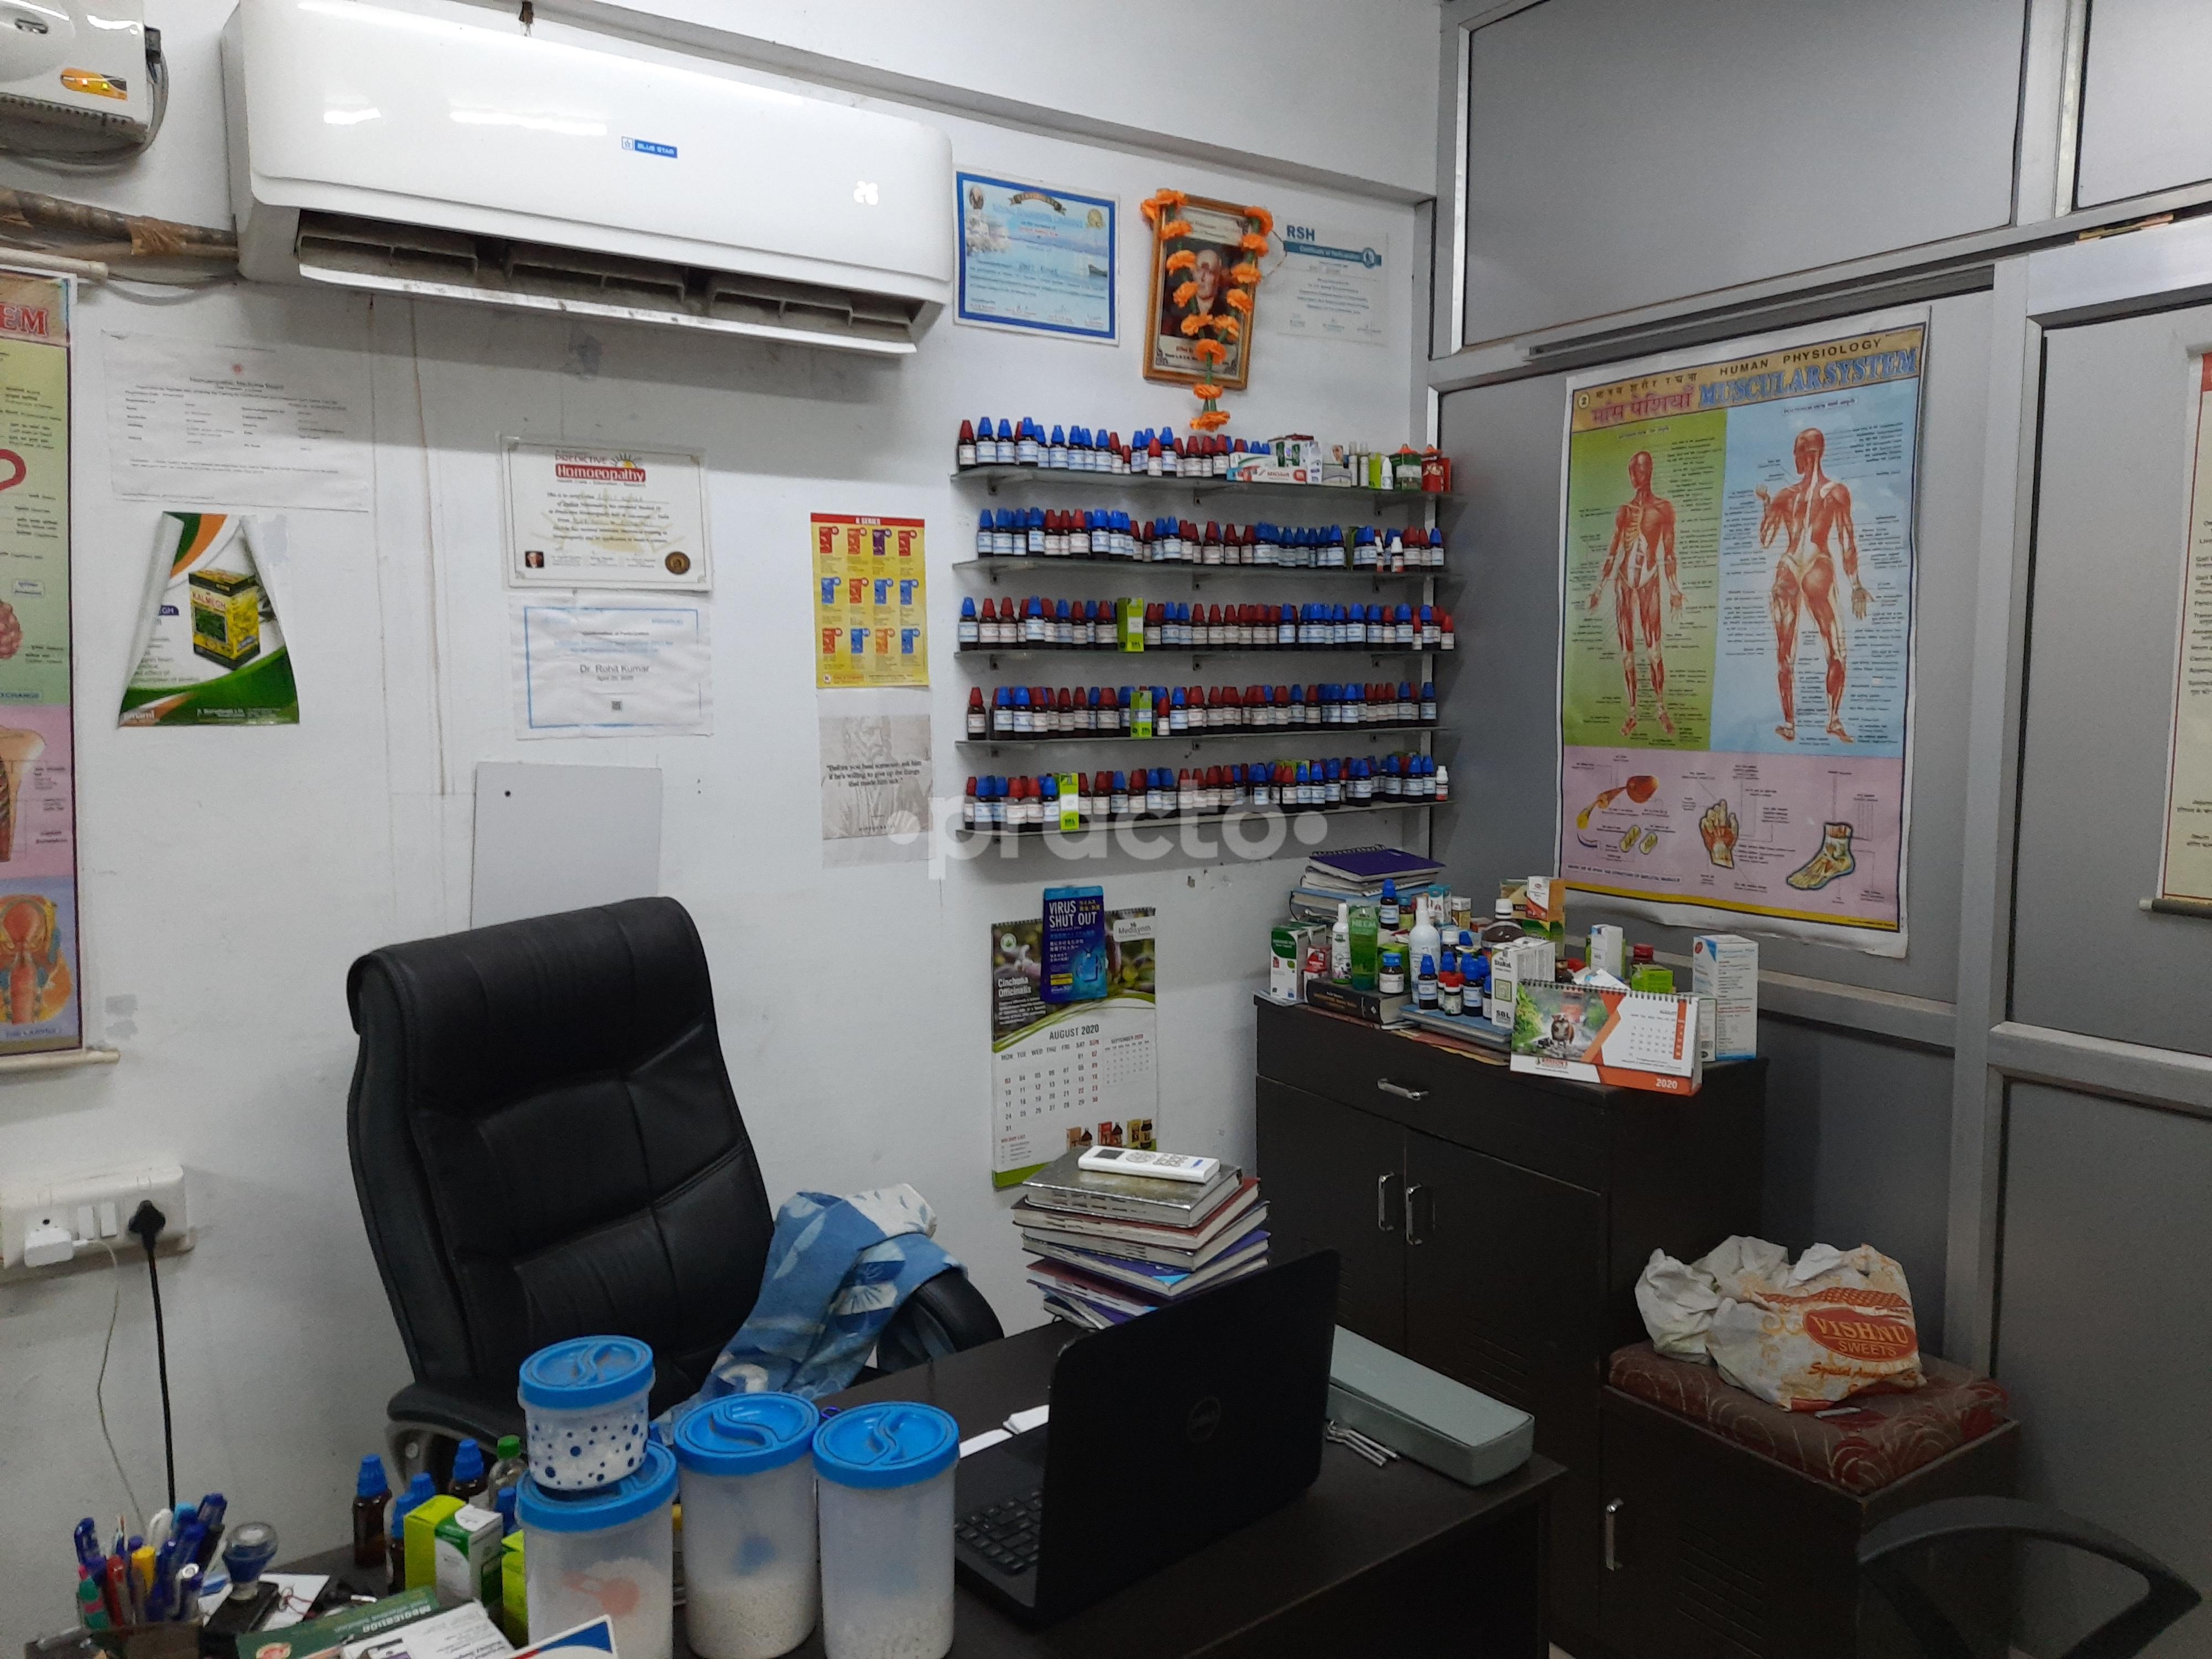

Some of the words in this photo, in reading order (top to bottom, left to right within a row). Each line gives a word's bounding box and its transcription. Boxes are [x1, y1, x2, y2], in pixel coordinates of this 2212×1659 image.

[637, 142, 655, 152] BLUE
[656, 145, 675, 155] STAR
[1286, 225, 1315, 241] RSH
[1719, 359, 1768, 376] HUMAN
[1782, 338, 1882, 364] PHYSIOLOGY
[557, 465, 644, 483] Homoeopathy
[1048, 900, 1077, 915] VIRUS
[1048, 913, 1074, 928] SHUT
[1078, 911, 1098, 926] OUT
[998, 977, 1029, 988] Cinchona
[998, 984, 1032, 998] Officinalis
[1496, 1009, 1511, 1020] SBL
[1049, 1026, 1079, 1040] AUGUST
[1081, 1024, 1100, 1035] 2020
[1656, 1078, 1678, 1089] 2020
[1809, 1314, 1908, 1344] VISHNU
[1838, 1340, 1897, 1356] SWEETS
